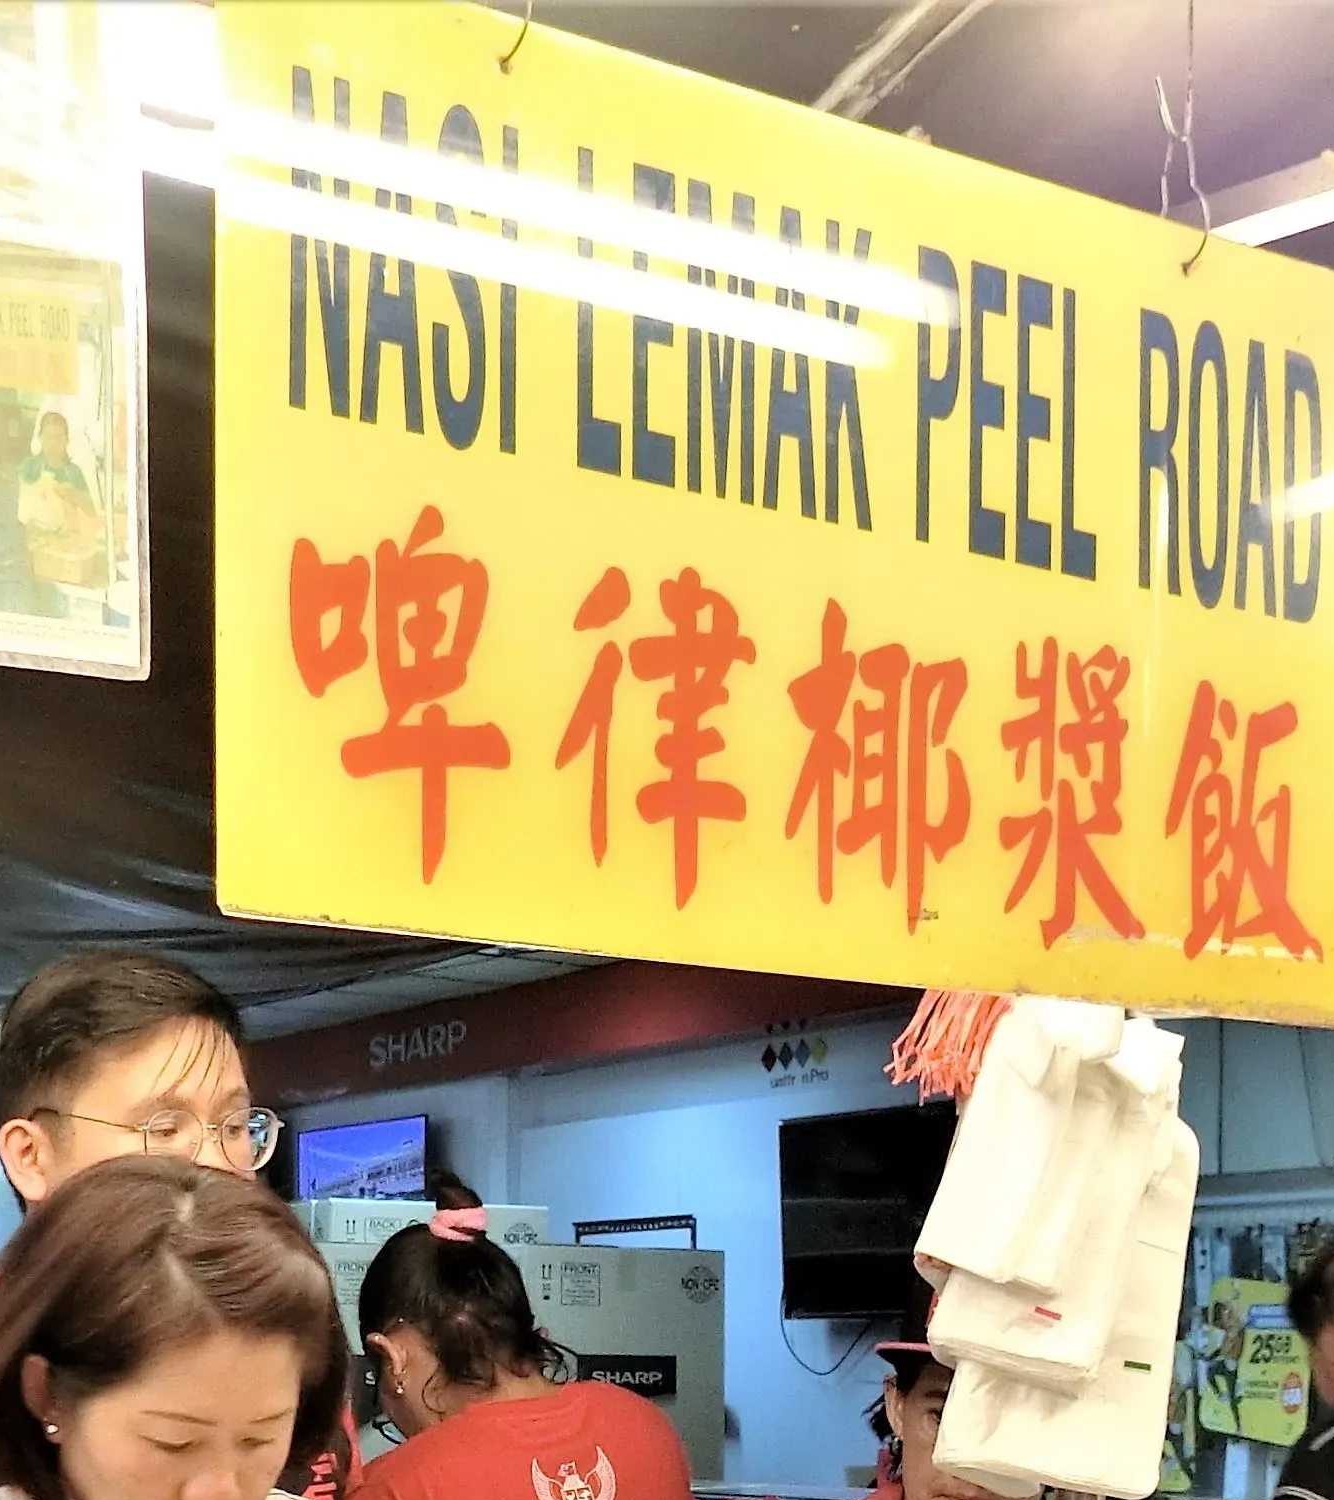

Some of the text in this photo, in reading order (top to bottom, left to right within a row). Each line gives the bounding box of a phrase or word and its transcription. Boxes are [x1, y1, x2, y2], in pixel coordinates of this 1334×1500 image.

[288, 65, 1323, 626] NASI LEMAK PEEL ROAD
[369, 1020, 467, 1072] SHARP
[592, 1370, 663, 1385] SHARP
